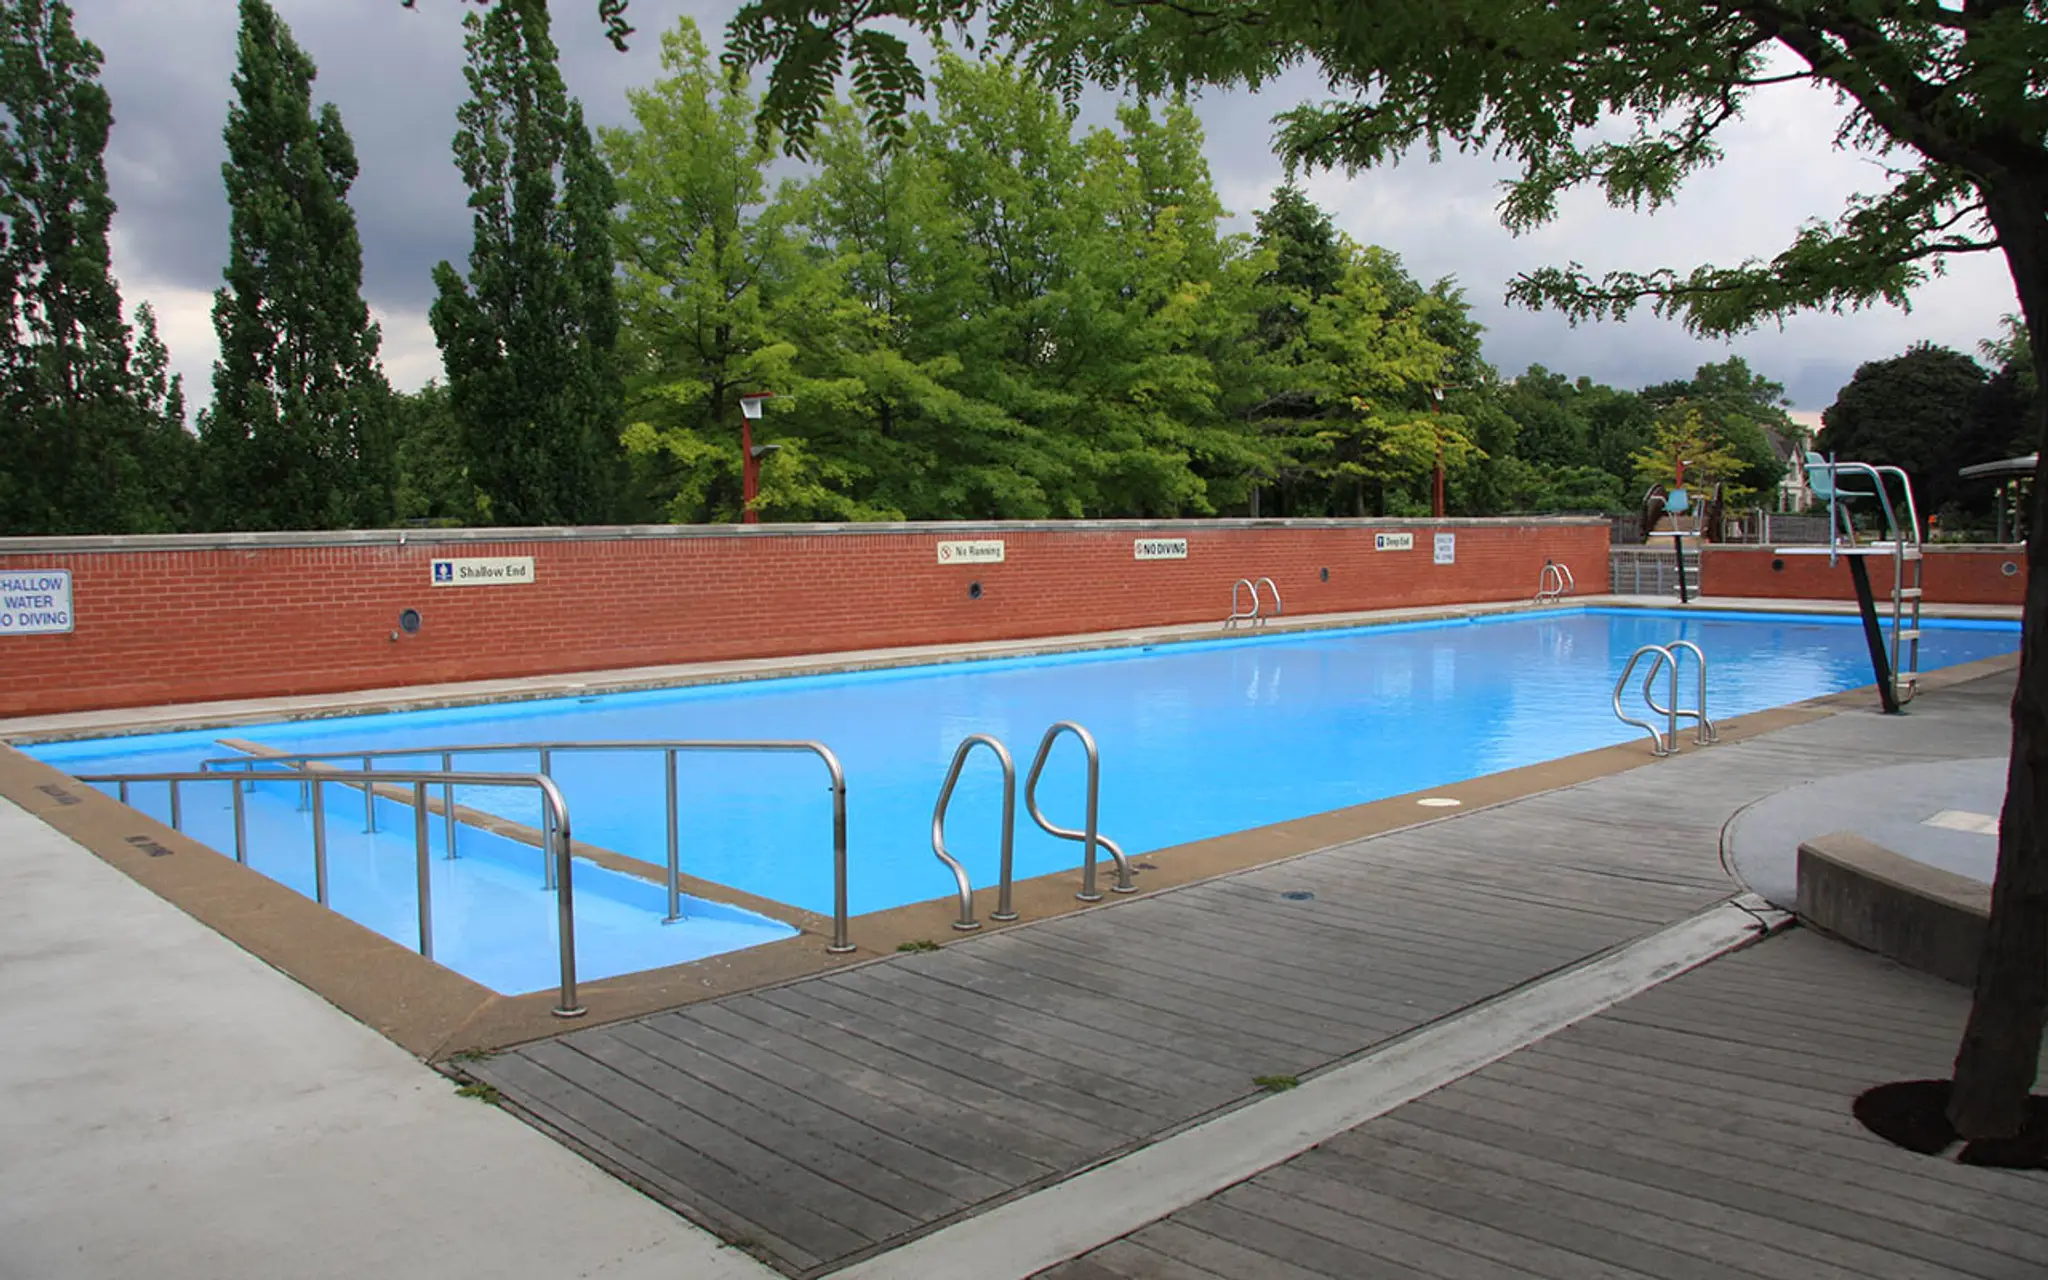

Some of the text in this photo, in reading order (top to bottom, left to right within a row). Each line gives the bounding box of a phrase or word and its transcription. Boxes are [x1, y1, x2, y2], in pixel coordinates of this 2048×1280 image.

[969, 546, 1000, 558] Running
[1144, 542, 1185, 555] NO DIVING
[460, 564, 526, 578] Shallow End
[0, 578, 62, 591] HALLOW
[4, 595, 53, 609] WATER
[0, 611, 68, 626] O DIVING
